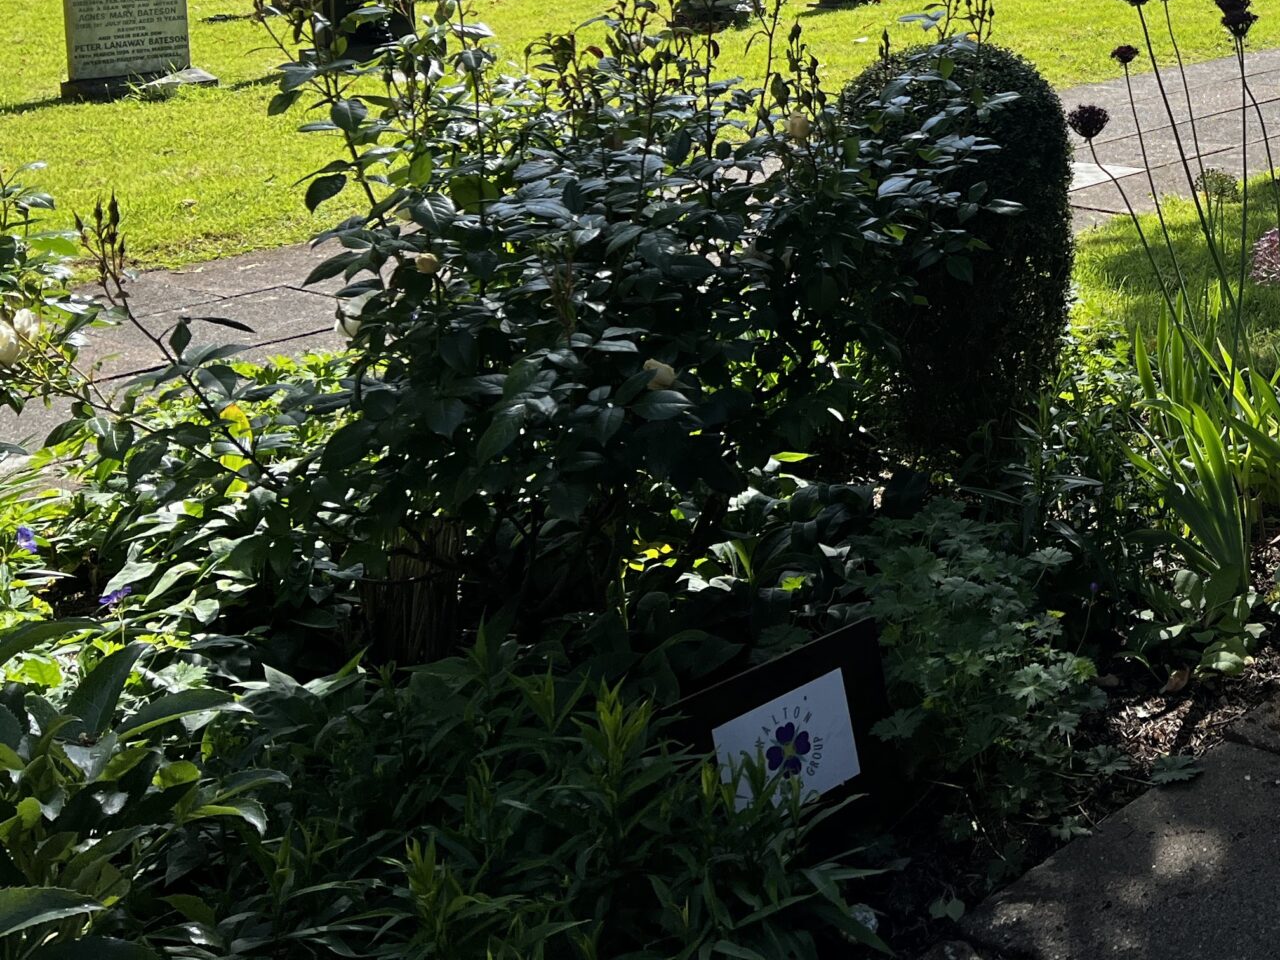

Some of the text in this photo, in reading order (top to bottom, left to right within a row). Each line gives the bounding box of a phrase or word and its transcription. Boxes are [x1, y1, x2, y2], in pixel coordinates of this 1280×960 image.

[78, 12, 105, 22] AGNES
[137, 6, 177, 17] BATESON
[75, 34, 187, 52] PETER LANAWAY BATESON
[754, 706, 824, 777] HALTON GROUP
